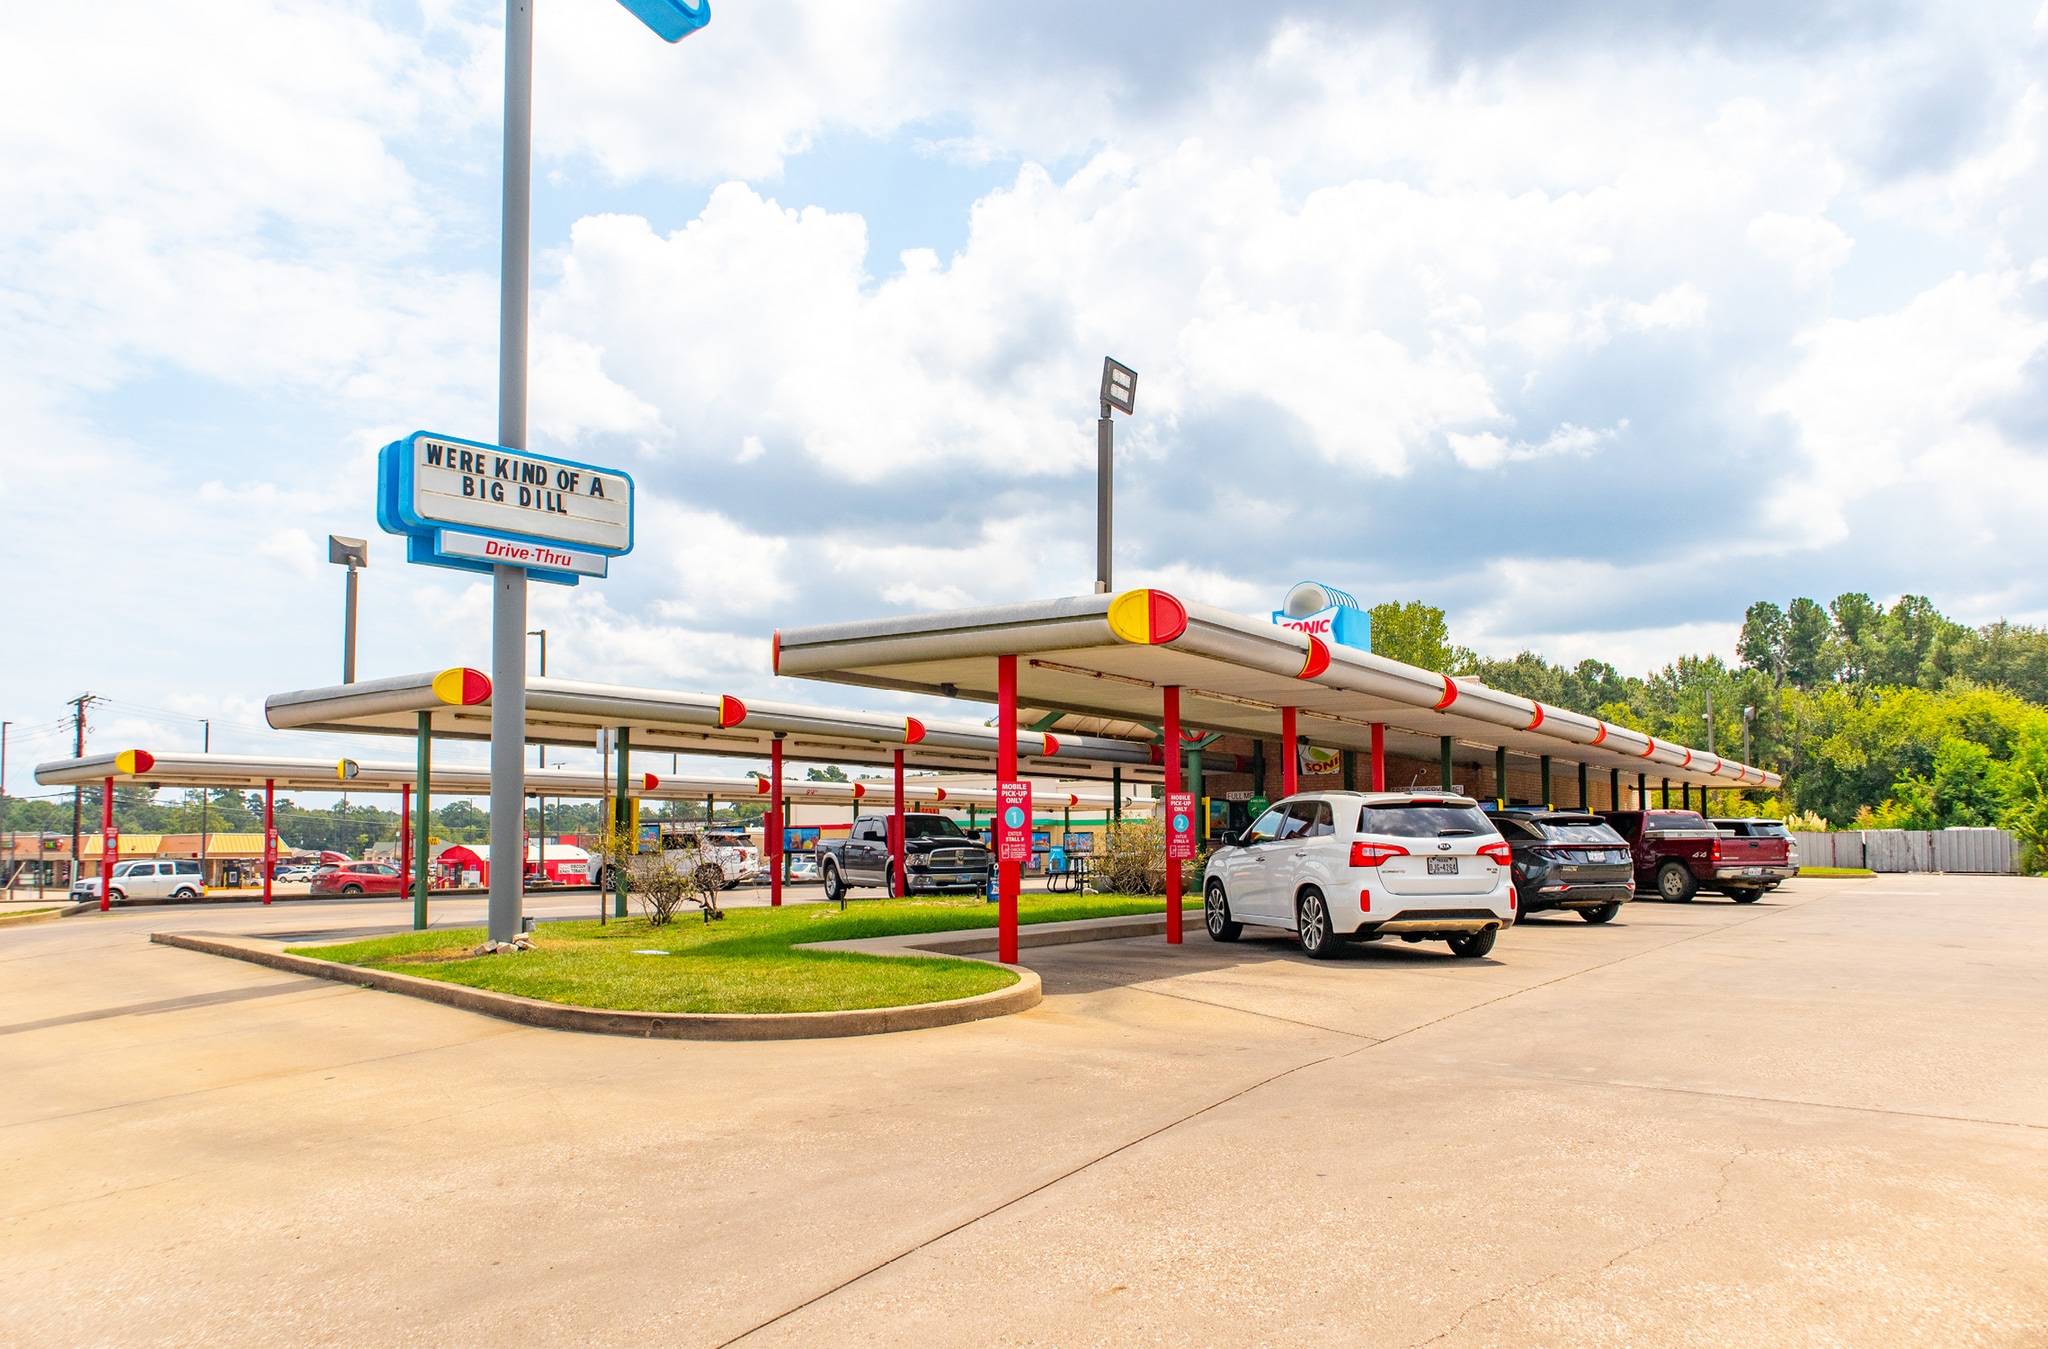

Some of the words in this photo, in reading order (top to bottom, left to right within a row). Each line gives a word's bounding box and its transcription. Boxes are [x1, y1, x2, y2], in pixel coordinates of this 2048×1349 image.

[426, 443, 486, 475] WERE
[495, 456, 547, 486] KIND
[557, 469, 580, 492] OF
[590, 477, 605, 498] A
[462, 475, 505, 503] BIG
[519, 486, 568, 514] DILL
[485, 540, 572, 568] Drive-Thru
[1304, 757, 1338, 771] SONI
[1227, 792, 1242, 800] FULL
[1177, 817, 1184, 829] 2
